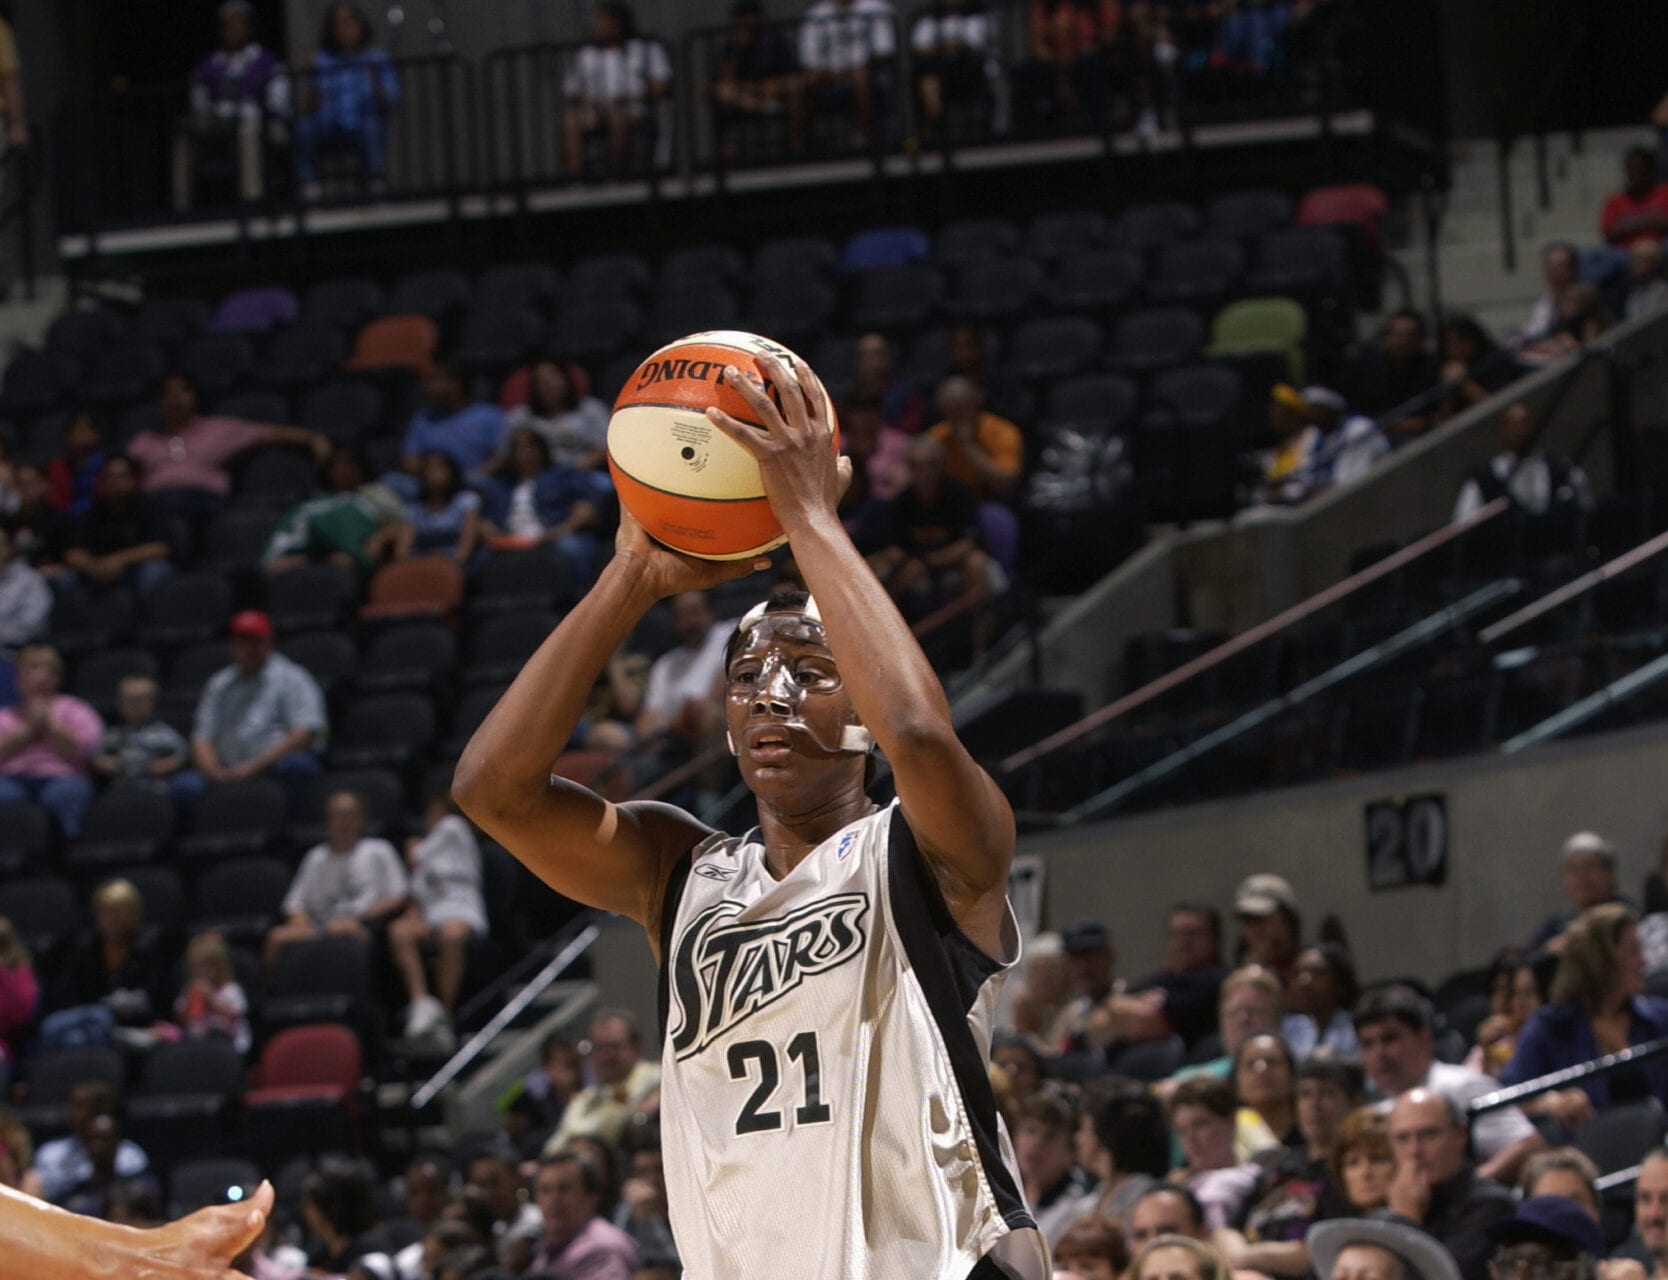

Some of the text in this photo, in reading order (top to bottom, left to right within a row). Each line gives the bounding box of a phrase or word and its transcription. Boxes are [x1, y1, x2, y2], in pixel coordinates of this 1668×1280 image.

[1370, 801, 1446, 883] 20
[670, 892, 870, 1063] STARS
[726, 1030, 833, 1137] 21
